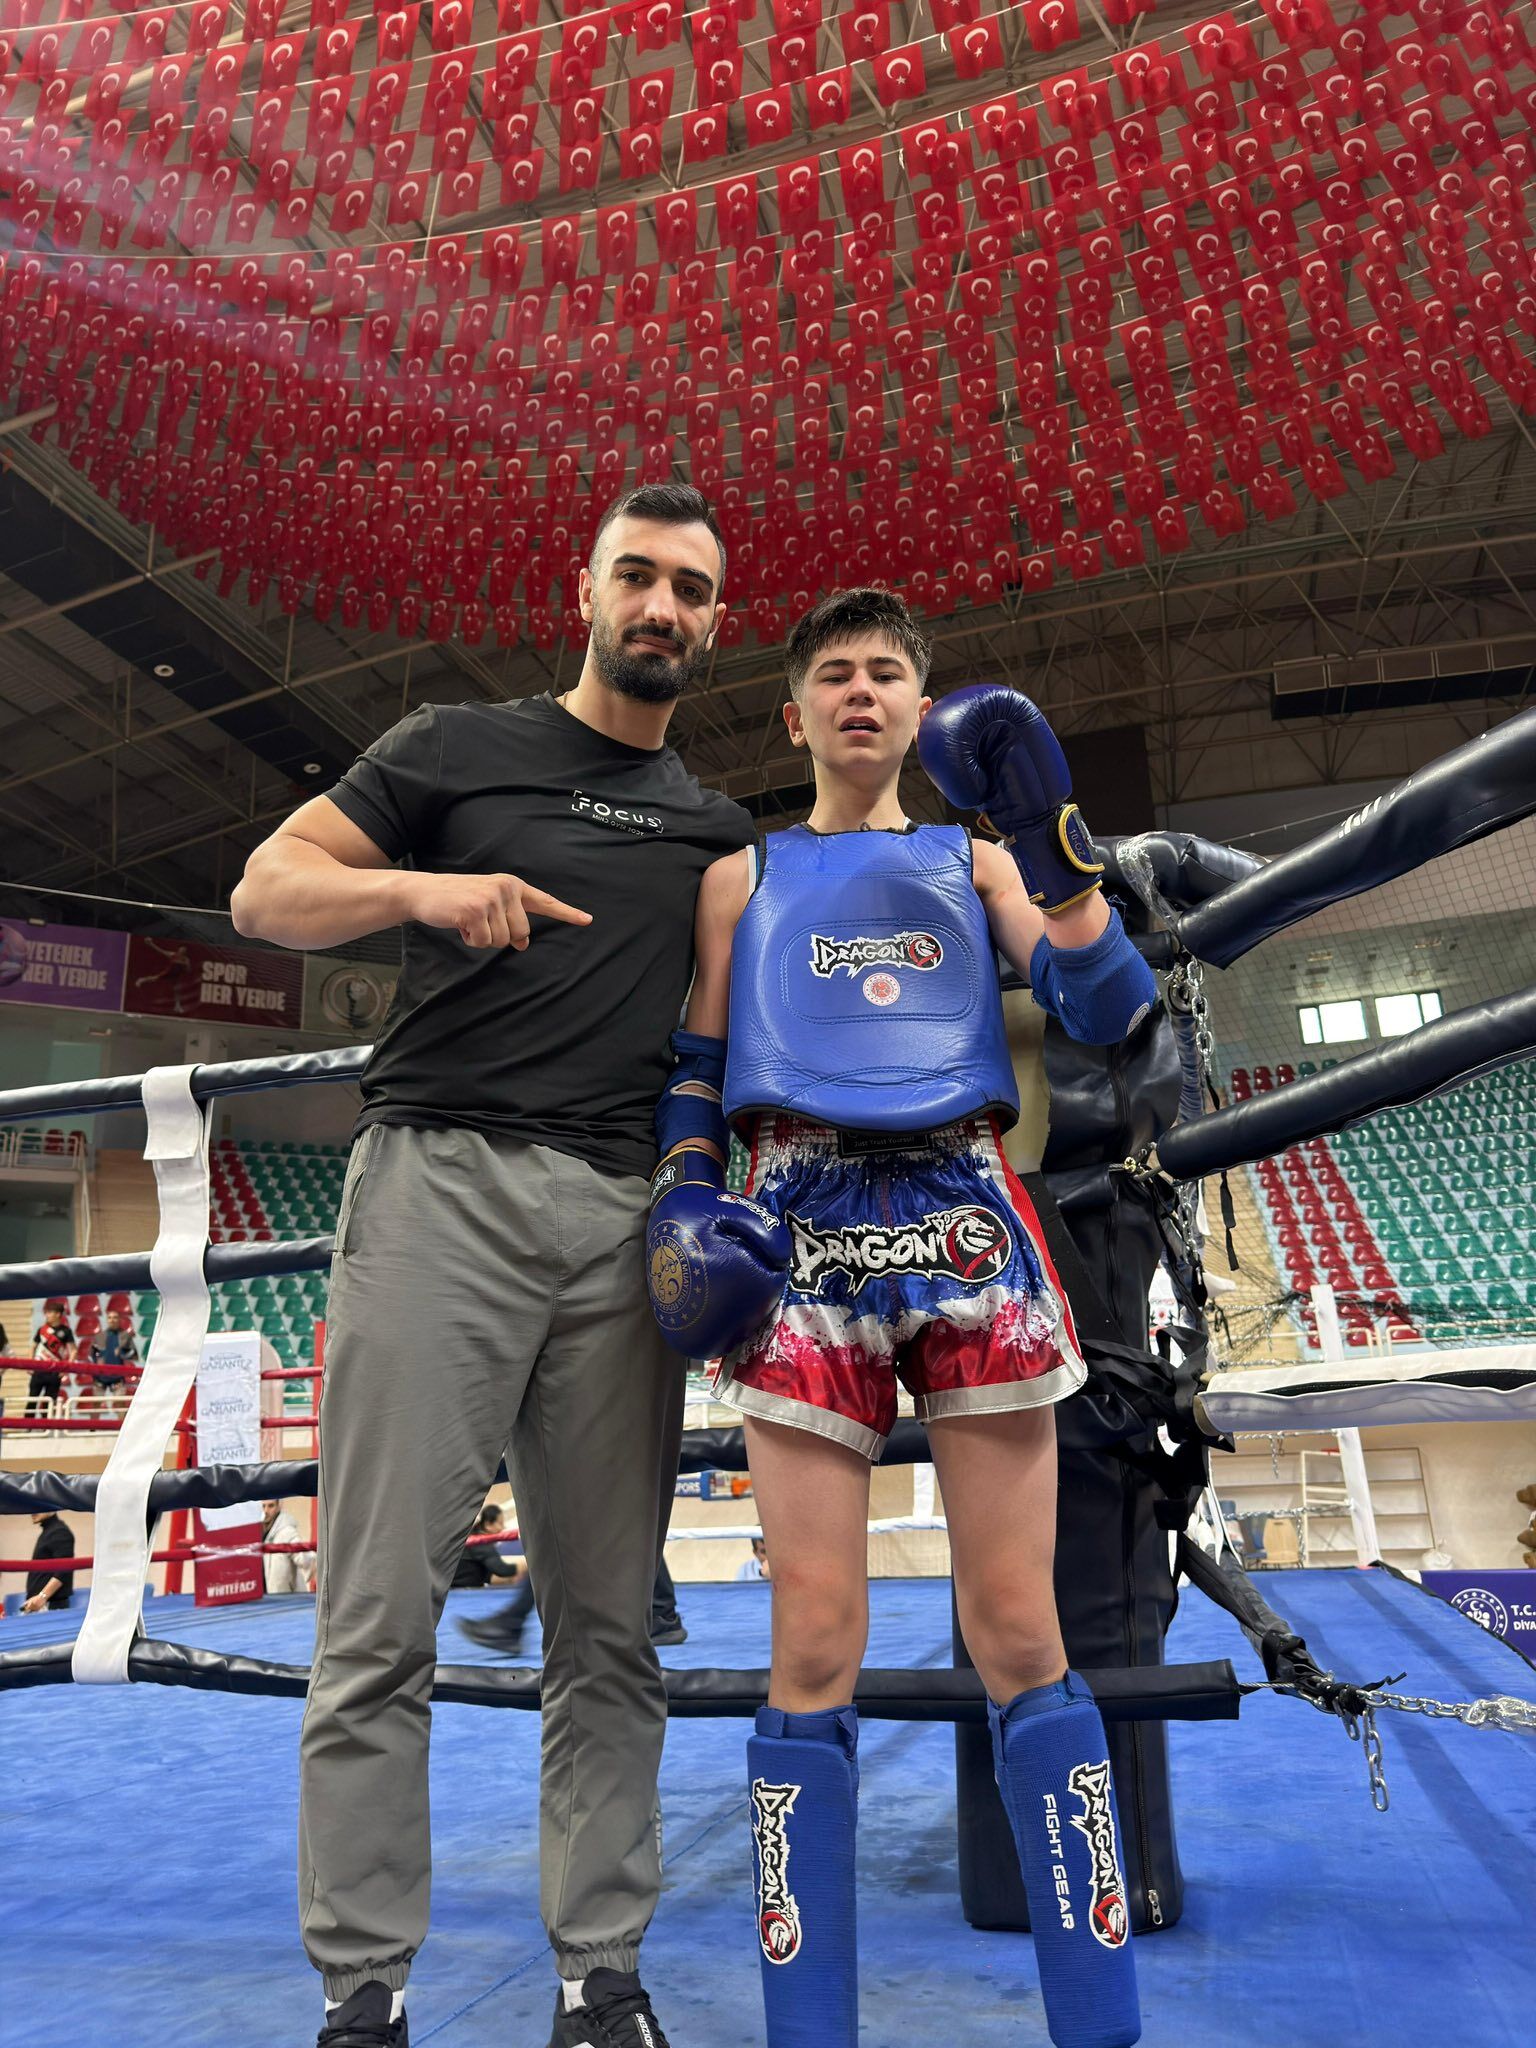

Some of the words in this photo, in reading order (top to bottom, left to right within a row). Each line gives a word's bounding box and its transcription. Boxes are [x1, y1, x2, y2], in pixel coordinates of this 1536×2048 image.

[578, 796, 659, 828] FOCUS
[57, 965, 108, 990] YERDE
[202, 961, 248, 985] SPOR
[816, 939, 905, 971] DRAGON
[200, 982, 232, 1006] HER
[236, 987, 286, 1012] YERDE
[791, 1219, 938, 1283] DRAGON
[755, 1790, 788, 1906] DRAGON
[1043, 1793, 1064, 1859] FIGHT
[1077, 1769, 1116, 1891] DRAGON
[1052, 1864, 1075, 1930] GEAR
